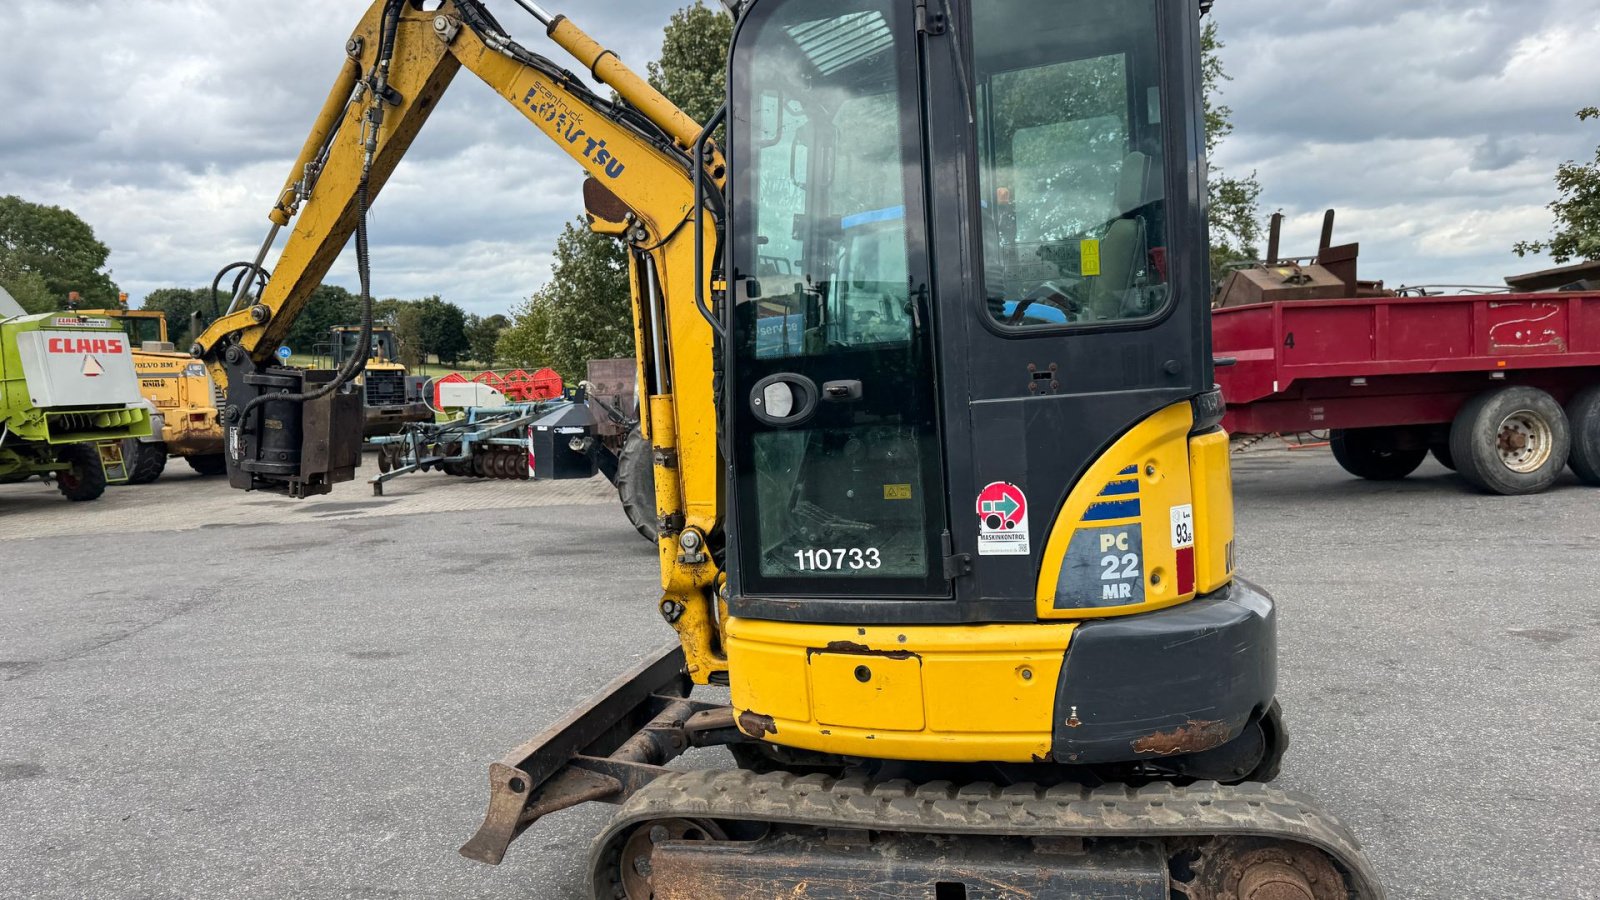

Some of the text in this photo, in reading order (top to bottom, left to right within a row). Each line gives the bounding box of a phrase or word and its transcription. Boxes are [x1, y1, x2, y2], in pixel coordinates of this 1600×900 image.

[533, 81, 584, 125] scantruck
[760, 321, 797, 336] servce
[48, 338, 123, 353] CLAAS
[1284, 332, 1295, 349] 4
[981, 533, 1026, 541] MASKINKONTROL
[1100, 532, 1128, 552] PC
[794, 547, 881, 570] 110733
[1101, 553, 1139, 580] 22
[1102, 583, 1131, 600] MR
